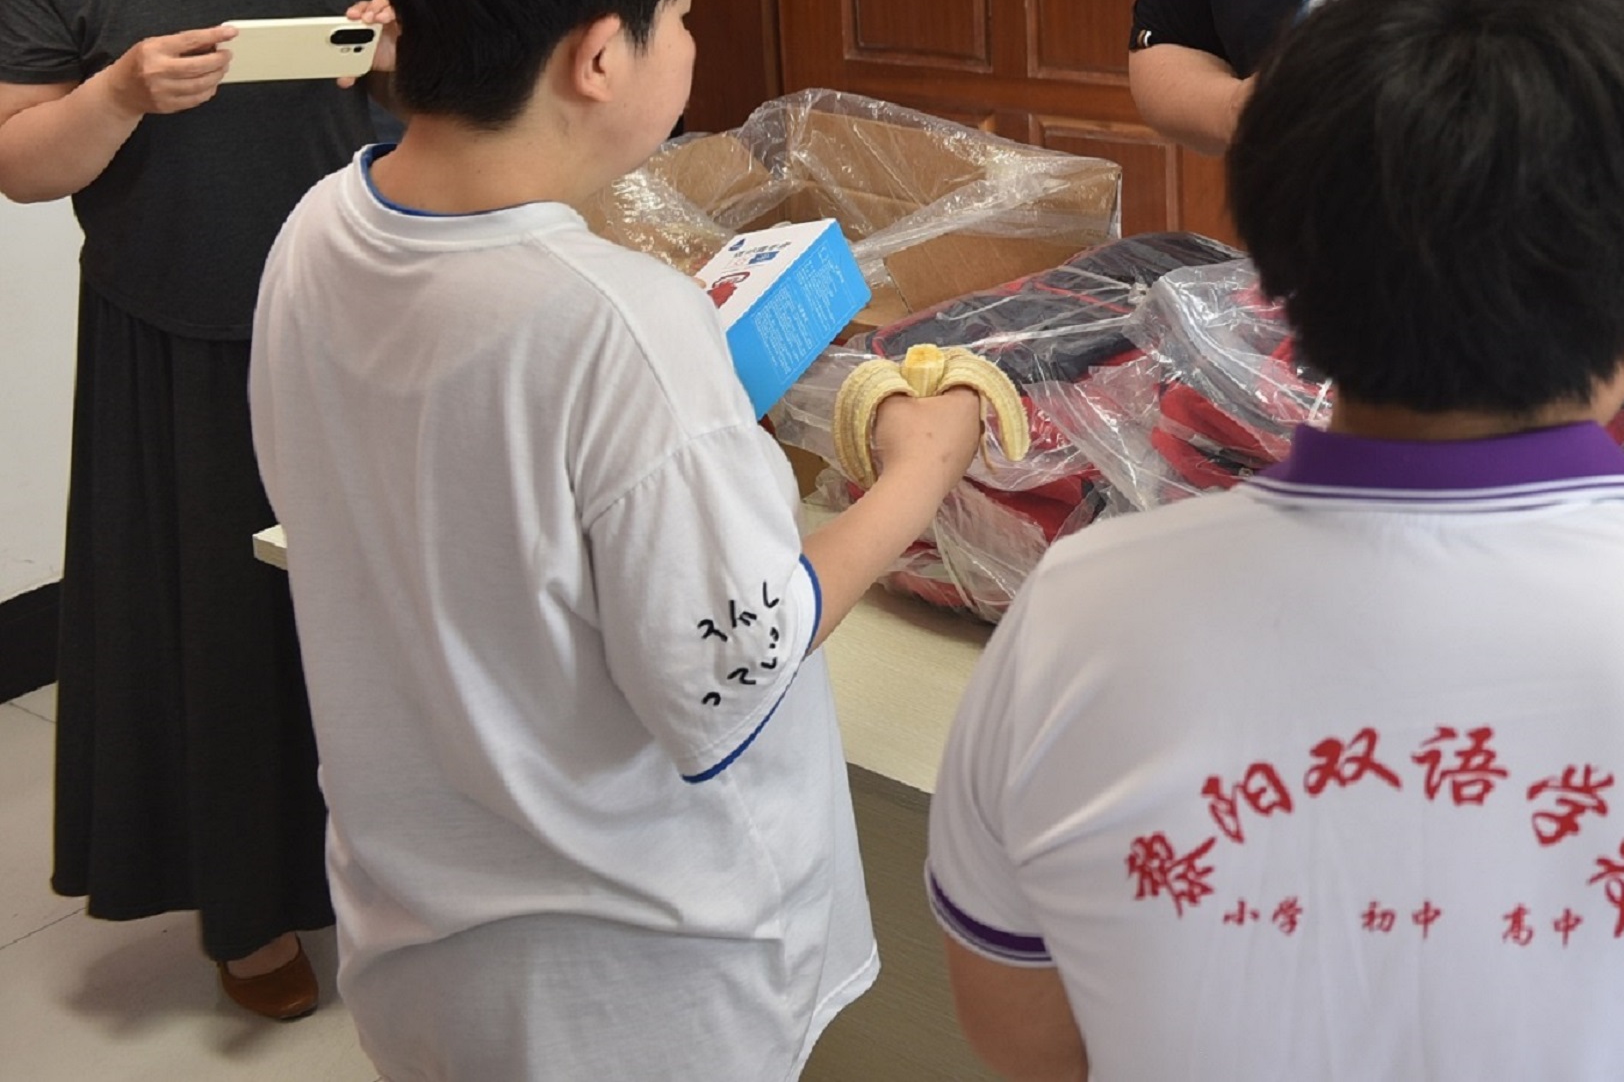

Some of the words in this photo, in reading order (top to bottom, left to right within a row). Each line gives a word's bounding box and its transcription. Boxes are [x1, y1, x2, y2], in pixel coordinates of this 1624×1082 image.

[1223, 898, 1303, 936] 小学
[1361, 899, 1441, 939] 初中
[1503, 903, 1583, 947] 高中
